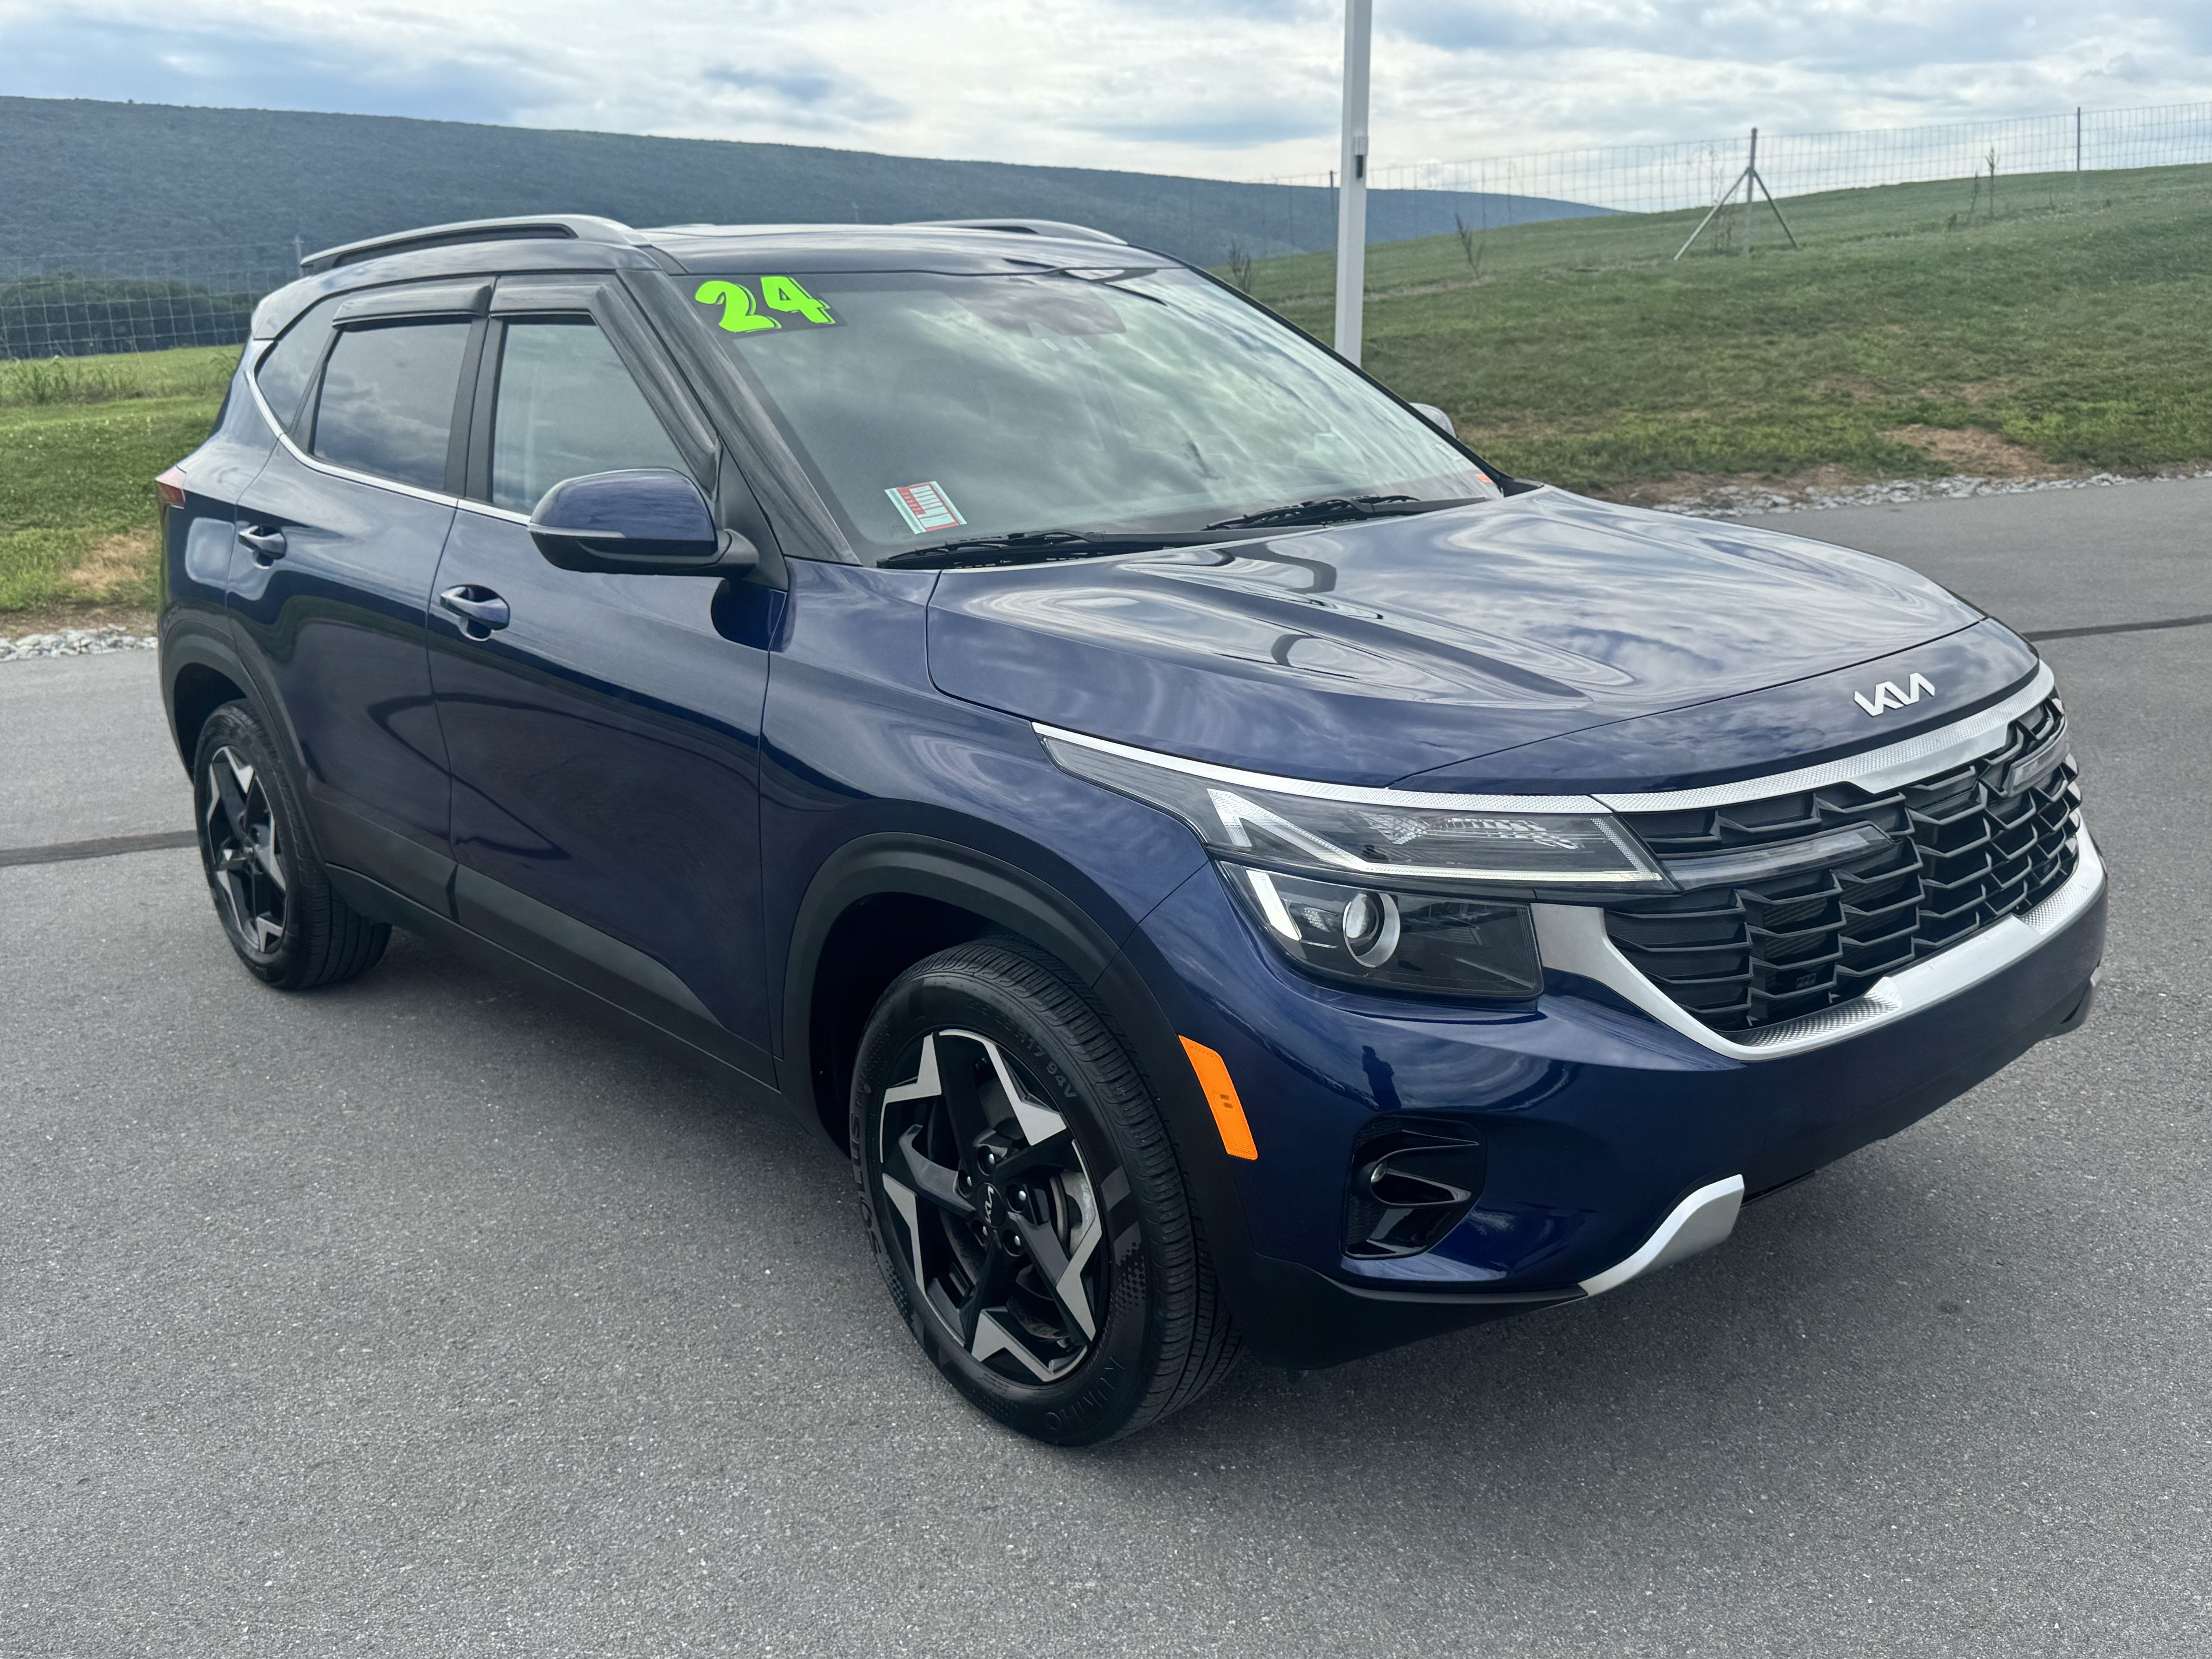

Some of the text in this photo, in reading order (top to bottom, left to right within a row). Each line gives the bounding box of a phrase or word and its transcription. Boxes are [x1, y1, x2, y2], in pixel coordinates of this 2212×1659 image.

[695, 276, 836, 333] 24
[1854, 672, 1935, 717] KIA
[1046, 1061, 1077, 1097] 94V
